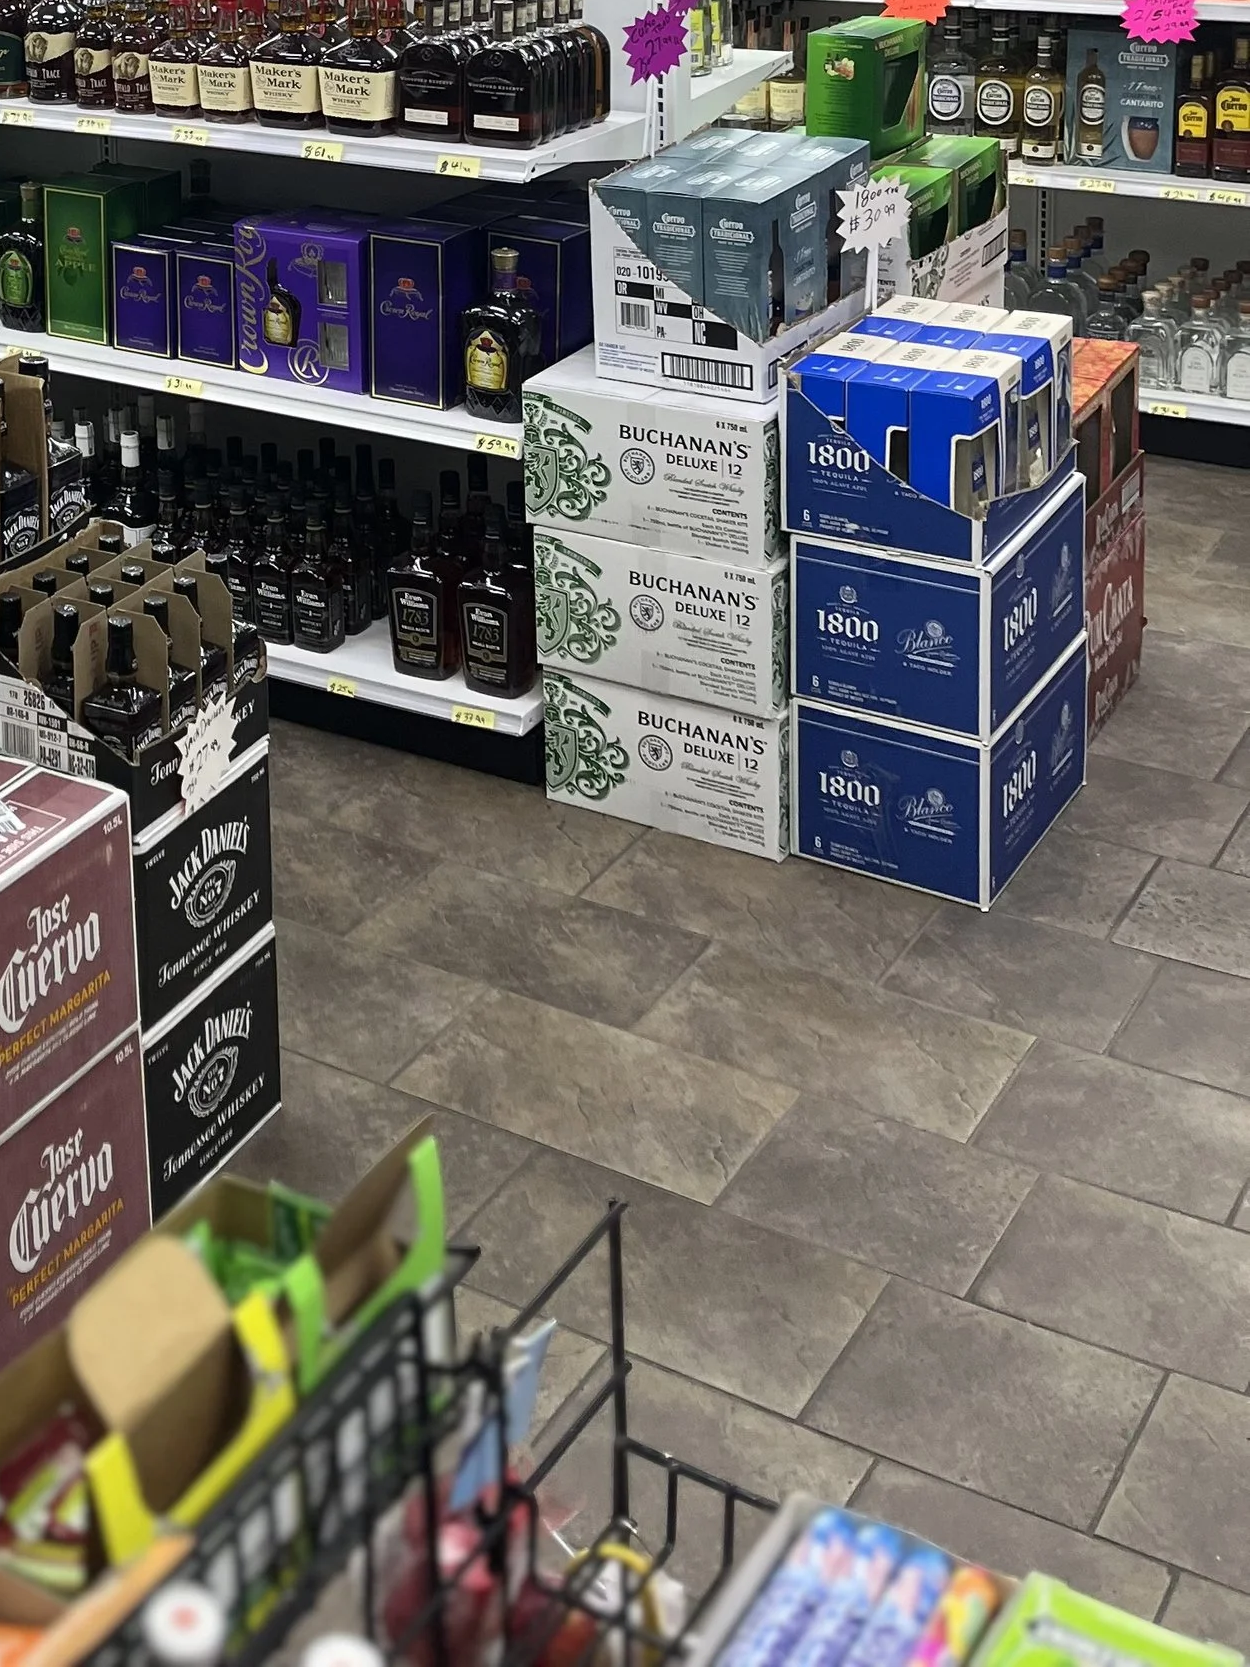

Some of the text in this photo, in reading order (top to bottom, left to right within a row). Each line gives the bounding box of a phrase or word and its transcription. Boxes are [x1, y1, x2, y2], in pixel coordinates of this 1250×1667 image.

[151, 64, 186, 75] Maker's
[158, 74, 185, 83] Mark
[200, 69, 236, 79] Maker's
[208, 78, 236, 88] Mark
[254, 64, 302, 78] Maker's
[266, 77, 302, 89] Mark
[324, 70, 371, 85] Maker's
[335, 81, 370, 97] Mark
[1120, 99, 1164, 109] CANTARITO
[55, 259, 96, 271] APPLE
[619, 425, 749, 459] BUCHANAN'S
[666, 453, 742, 477] DELUXE 12
[807, 441, 870, 473] 1800
[820, 469, 859, 482] TEQUILA
[712, 508, 747, 519] CONTENTS
[629, 571, 757, 611] BUCHANAN'S
[402, 609, 429, 625] 1783
[675, 601, 750, 626] DELUXE 12
[816, 608, 879, 643] 1800
[1003, 587, 1037, 652] 1800
[473, 625, 500, 640] 1783
[830, 638, 868, 651] TEQUILA
[897, 627, 954, 654] Blanco
[638, 711, 765, 756] BUCHANAN'S
[684, 742, 758, 771] DELUXE 12
[819, 771, 880, 806] 1800
[1003, 750, 1037, 818] 1800
[898, 797, 954, 821] Blanco
[170, 816, 250, 910] JACK DANIEL'S
[27, 894, 70, 954] Jose
[213, 890, 261, 939] WHISKEY
[49, 970, 111, 1025] MARGARITA
[174, 1000, 253, 1103] JACK DANIEL'S
[217, 1072, 266, 1125] WHISKEY
[39, 1128, 83, 1183] Jose
[9, 1142, 114, 1273] Cuervo
[62, 1198, 124, 1261] MARGARITA
